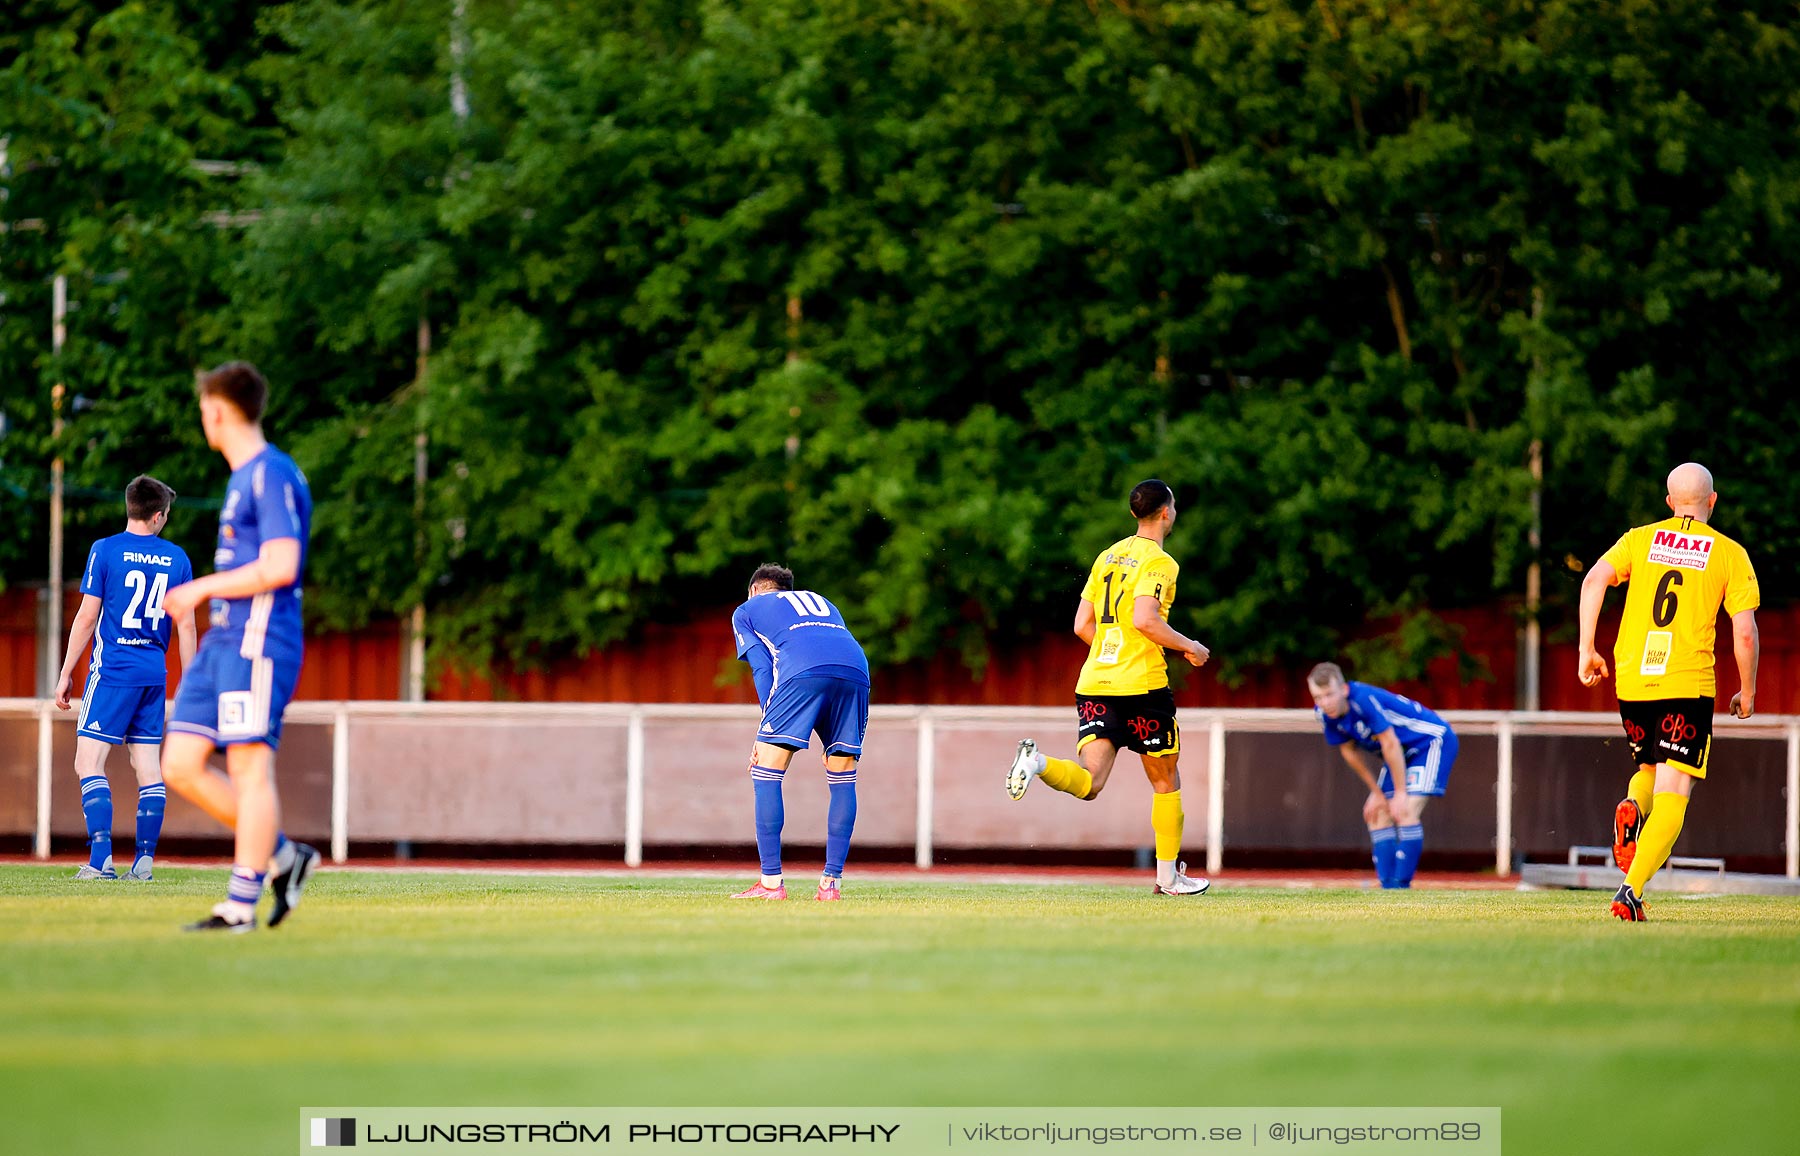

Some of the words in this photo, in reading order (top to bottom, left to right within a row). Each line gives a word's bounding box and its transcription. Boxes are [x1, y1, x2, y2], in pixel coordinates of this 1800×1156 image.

[1654, 531, 1711, 553] MAXI
[123, 551, 173, 567] RIMAC
[121, 569, 169, 631] 24
[776, 590, 831, 617] 10
[1652, 569, 1684, 628] 6
[1646, 656, 1664, 665] BRO
[1647, 649, 1666, 658] KUM
[1661, 713, 1697, 743] ÖBO
